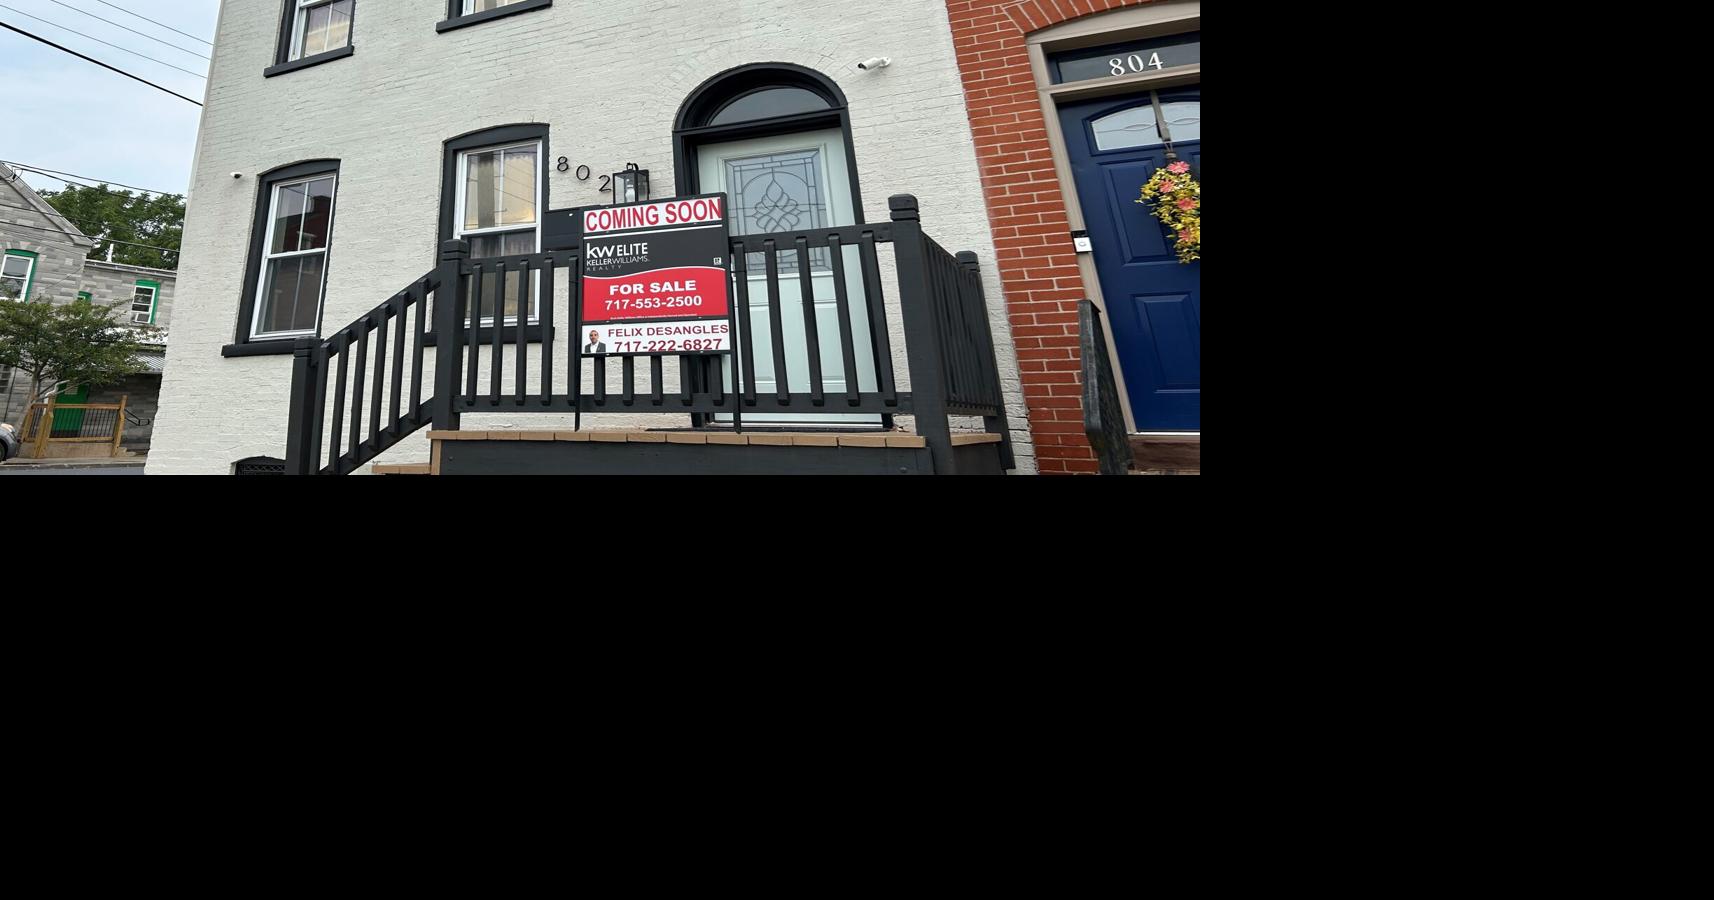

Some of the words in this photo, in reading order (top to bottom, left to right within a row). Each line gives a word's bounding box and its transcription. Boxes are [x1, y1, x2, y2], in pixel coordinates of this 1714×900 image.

[1109, 52, 1163, 76] 804
[557, 156, 611, 192] 802
[586, 205, 659, 231] COMING
[665, 198, 721, 223] SOON
[616, 242, 648, 257] ELITE
[609, 283, 645, 296] FOR
[650, 280, 697, 293] SALE
[605, 295, 702, 311] 717-553-2500
[608, 328, 643, 338] FELIX
[646, 324, 729, 336] DESANGLES
[614, 338, 722, 352] 717-222-6827
